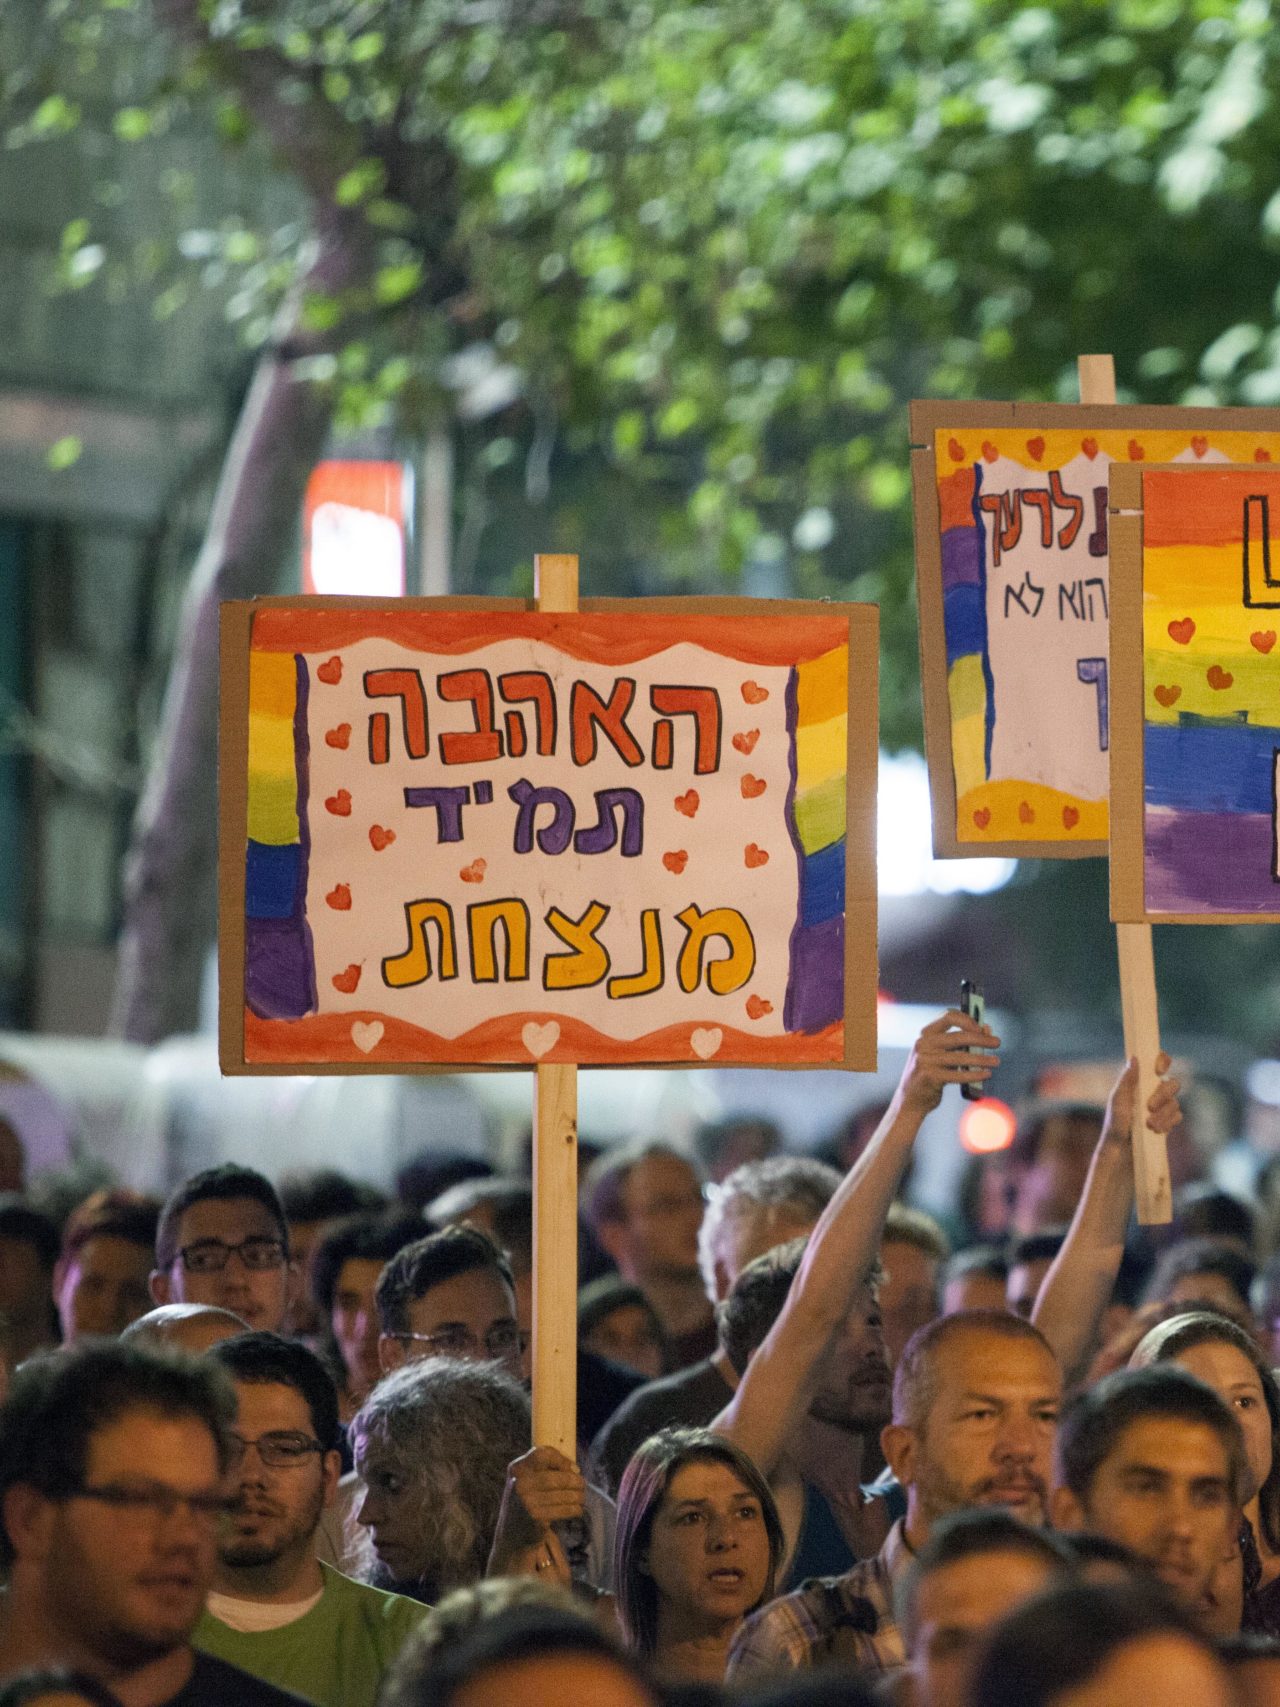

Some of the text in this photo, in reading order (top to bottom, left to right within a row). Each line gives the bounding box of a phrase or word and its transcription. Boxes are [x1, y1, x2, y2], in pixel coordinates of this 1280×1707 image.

[1004, 570, 1109, 622] הוא לא
[363, 668, 722, 775] האהבה
[404, 778, 645, 858] תמיד
[381, 898, 757, 999] מנצחת
